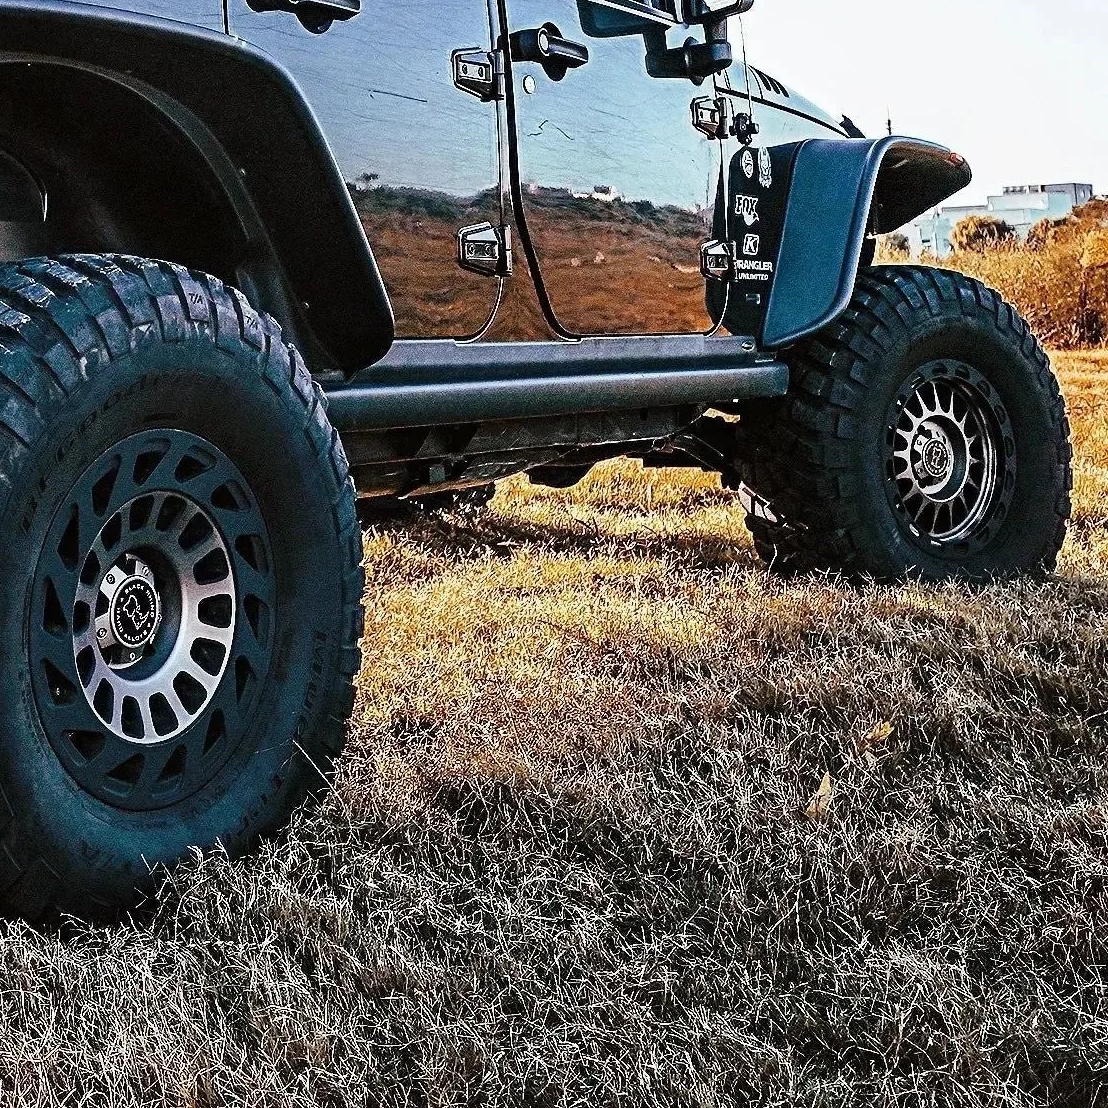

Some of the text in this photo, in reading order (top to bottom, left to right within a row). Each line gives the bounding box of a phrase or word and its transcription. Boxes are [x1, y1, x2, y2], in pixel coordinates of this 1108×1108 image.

[734, 195, 758, 216] FOX
[188, 293, 203, 304] T/A
[125, 583, 155, 618] BLACK RHINO
